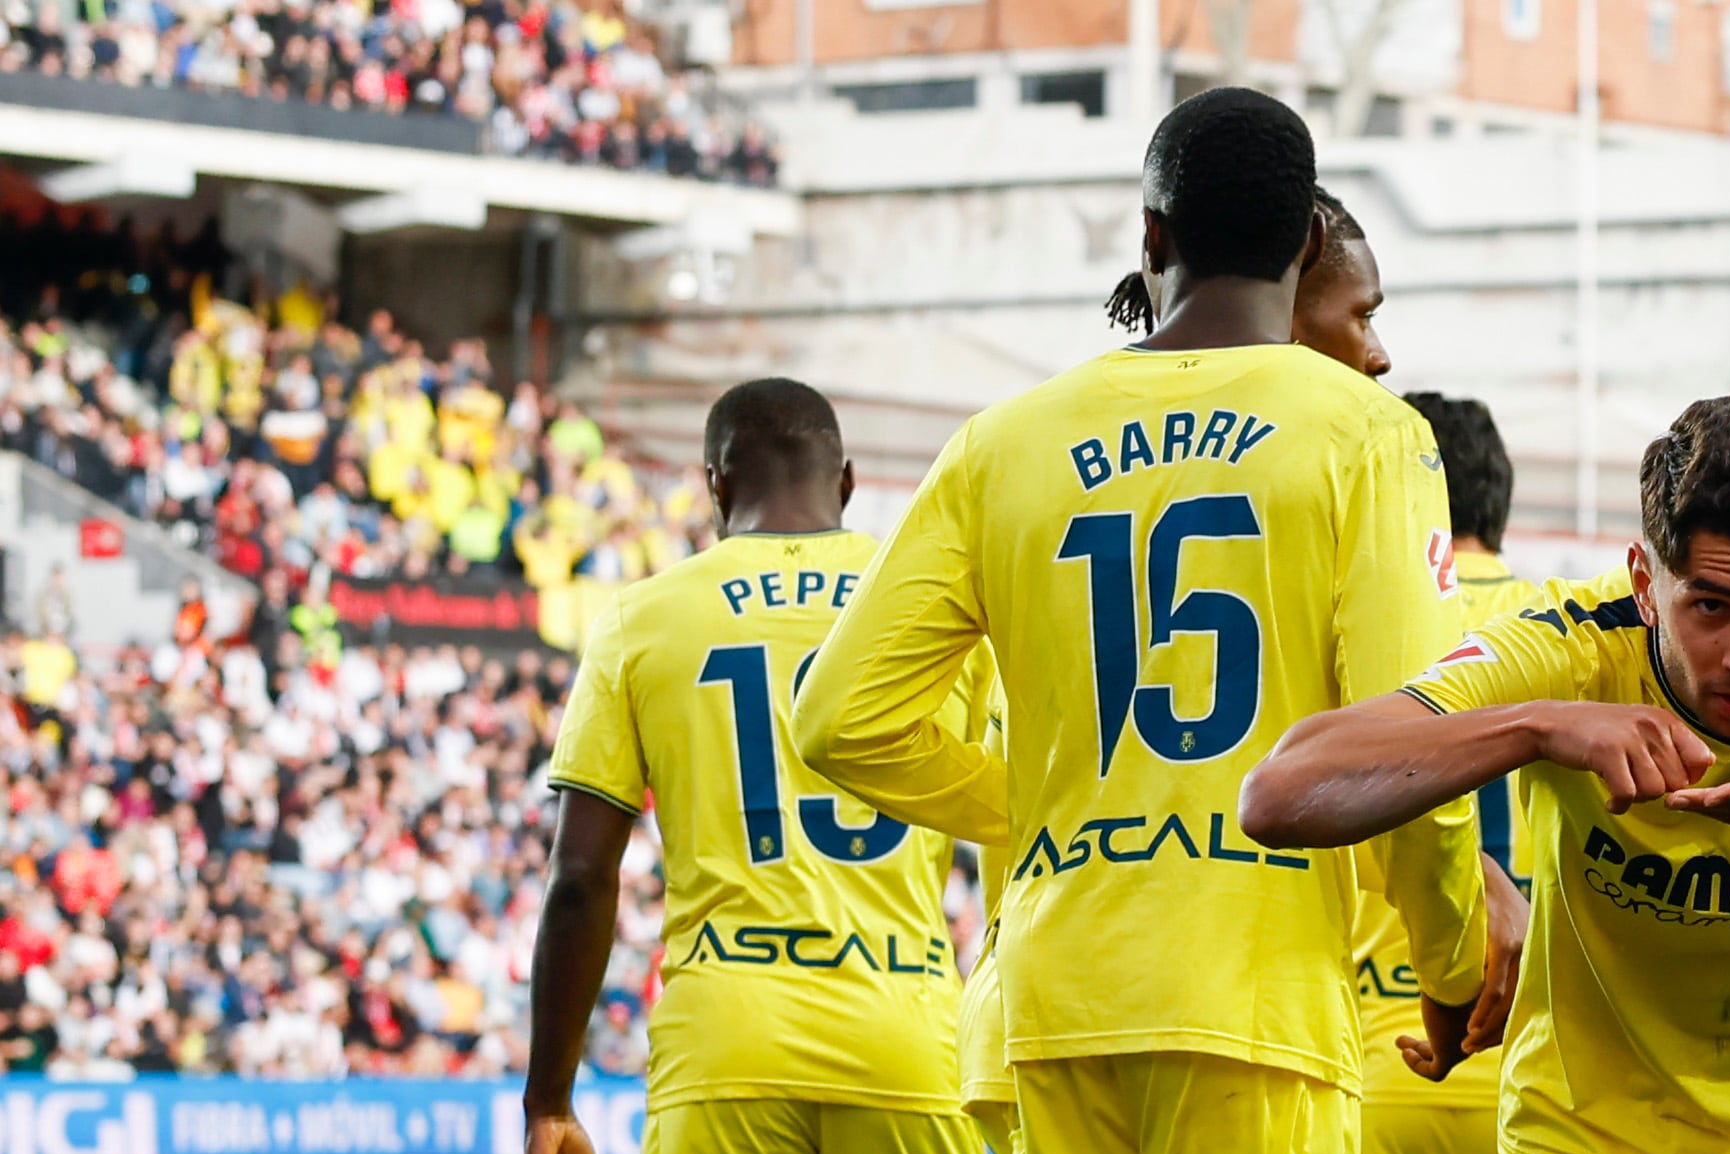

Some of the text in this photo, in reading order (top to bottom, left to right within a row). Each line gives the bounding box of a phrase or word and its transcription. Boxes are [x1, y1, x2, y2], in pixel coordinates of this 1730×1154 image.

[1069, 407, 1276, 492] BARRY
[720, 571, 863, 617] PEPE
[1053, 493, 1263, 780] 15
[679, 920, 946, 978] ASCALE
